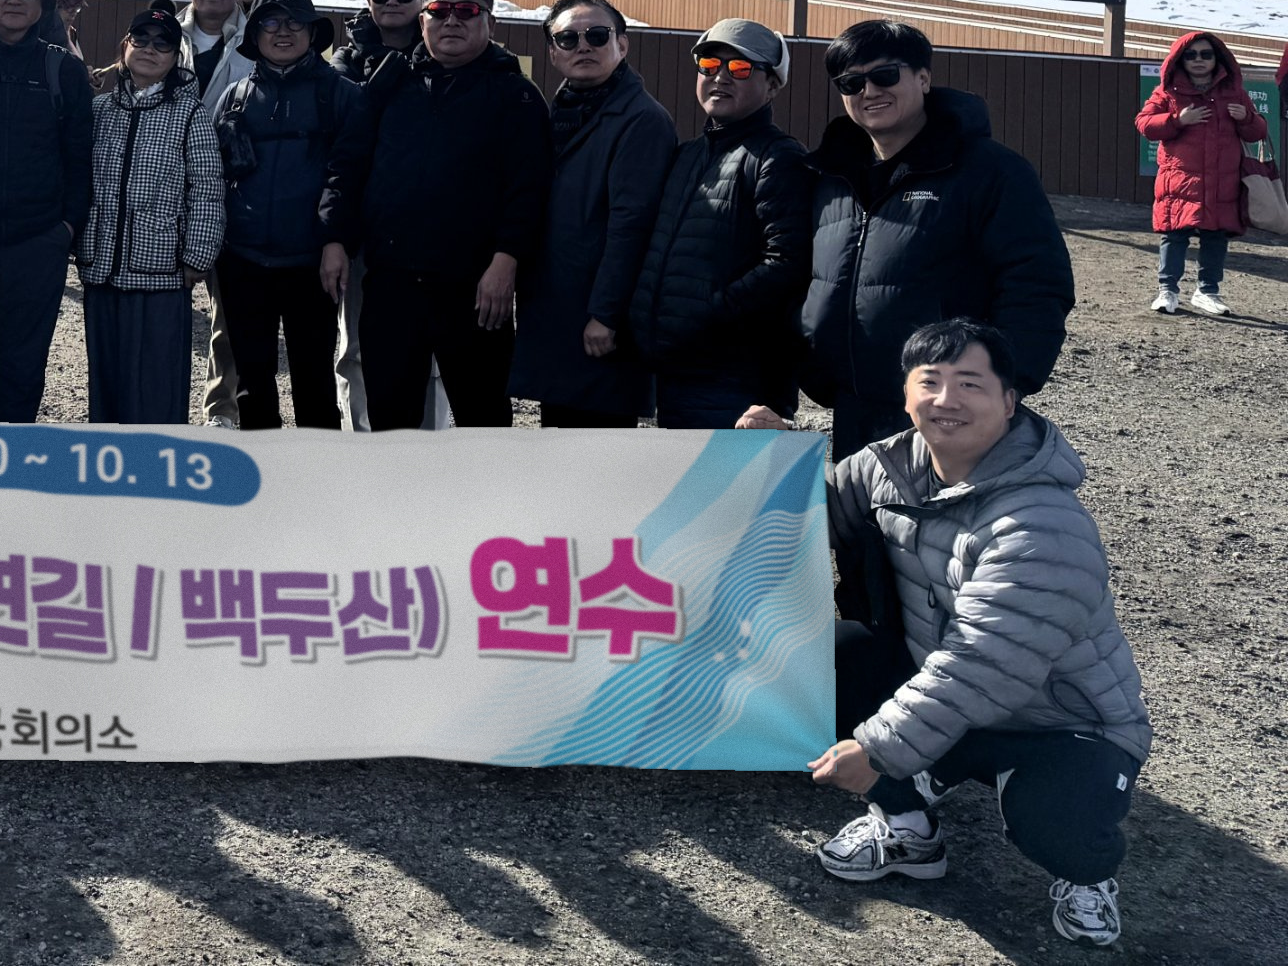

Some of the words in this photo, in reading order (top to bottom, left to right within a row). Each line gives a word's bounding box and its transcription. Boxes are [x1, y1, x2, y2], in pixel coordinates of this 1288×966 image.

[68, 442, 138, 485] 10.
[158, 447, 213, 490] 13
[179, 564, 441, 659] 백두산)
[469, 536, 678, 656] 연수
